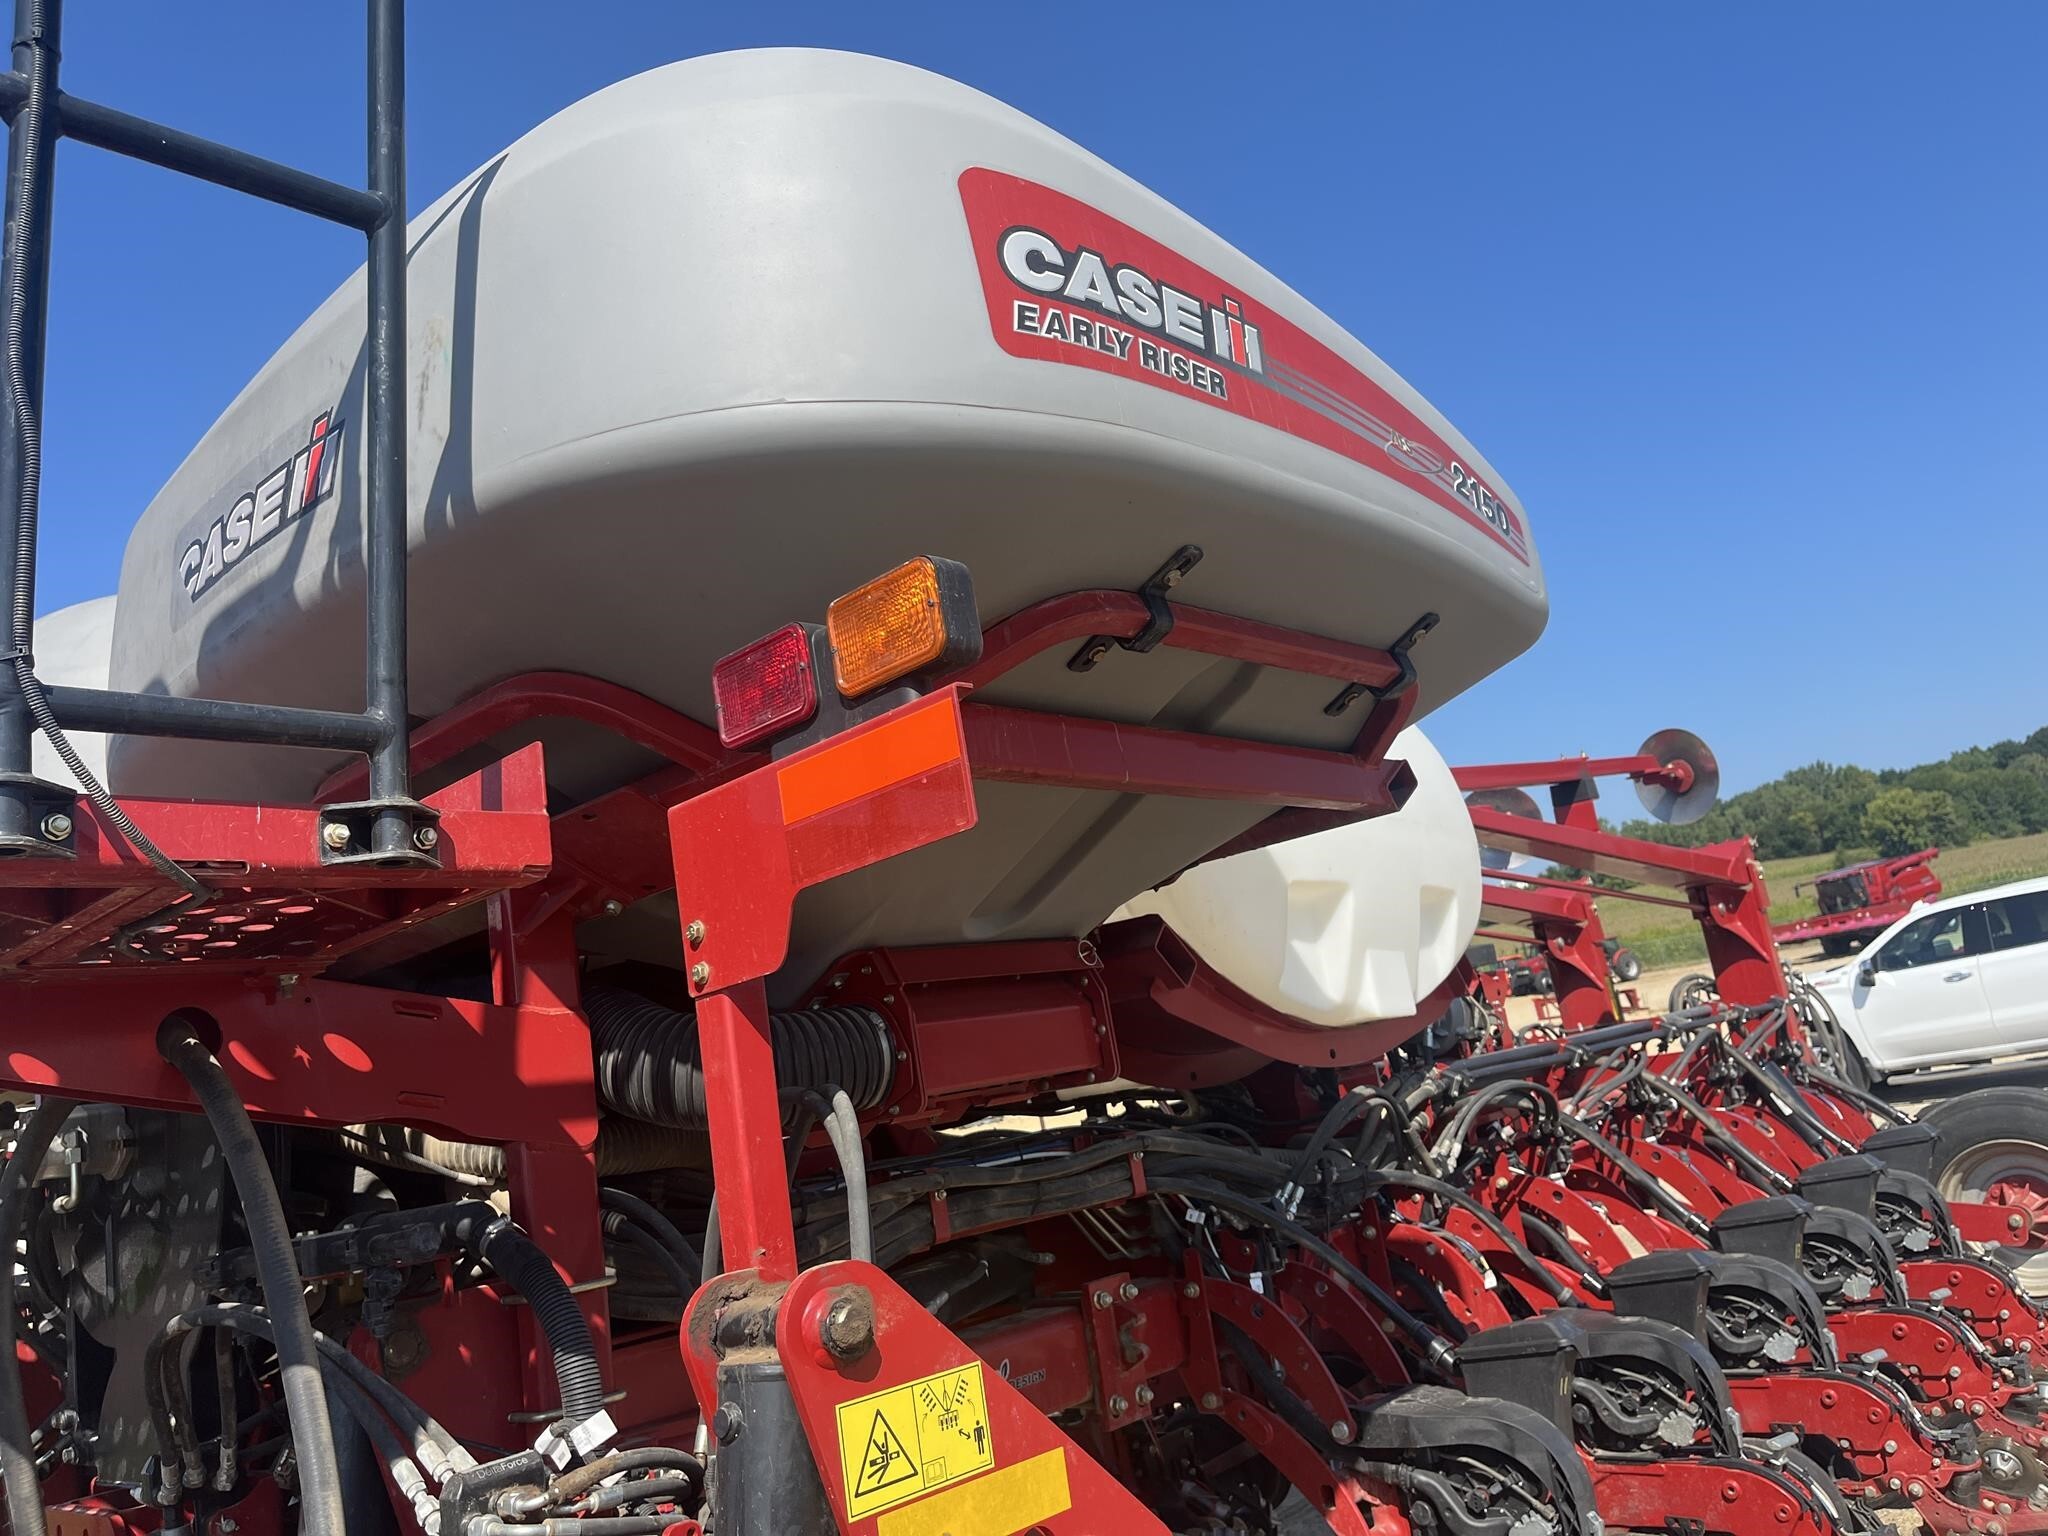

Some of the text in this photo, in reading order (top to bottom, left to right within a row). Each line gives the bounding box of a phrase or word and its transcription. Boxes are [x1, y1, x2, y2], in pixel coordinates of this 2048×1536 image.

[1000, 228, 1206, 351] CASE
[1013, 299, 1228, 400] EARLY RISER
[178, 466, 288, 594] CASE
[1450, 461, 1511, 537] 2150
[476, 1457, 529, 1479] DeltaForce
